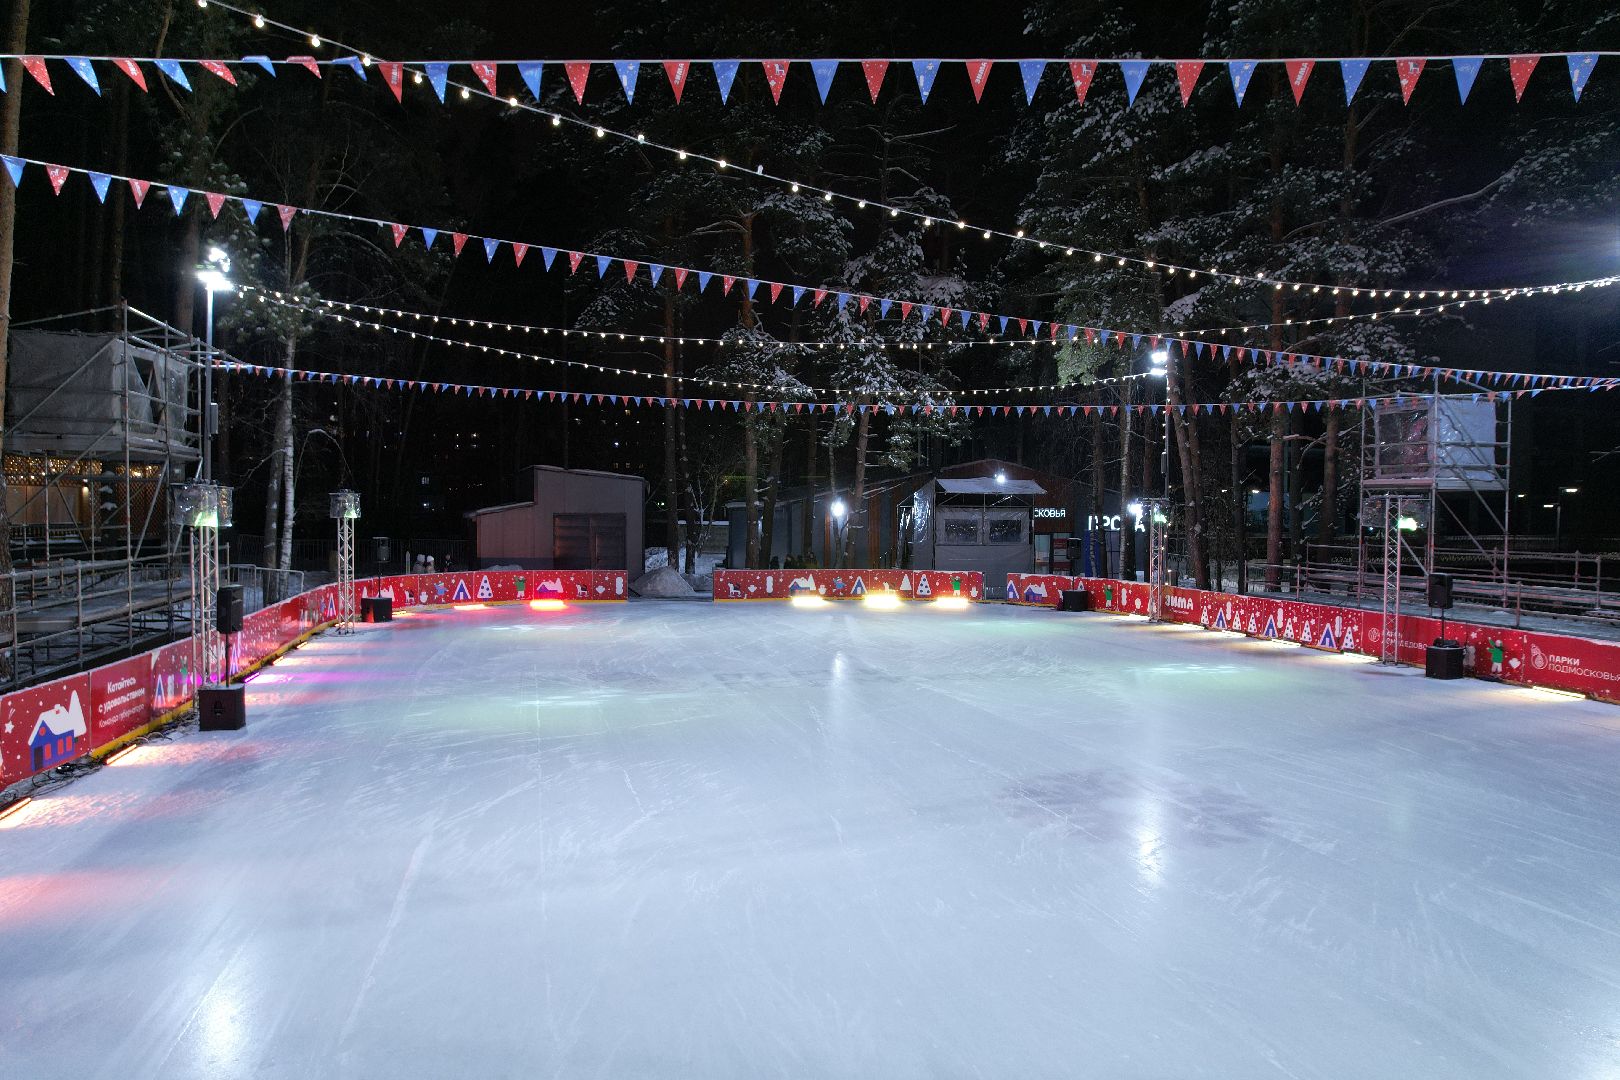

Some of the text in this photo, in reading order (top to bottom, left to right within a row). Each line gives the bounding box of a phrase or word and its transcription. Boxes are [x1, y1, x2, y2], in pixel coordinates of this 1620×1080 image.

[1165, 594, 1194, 610] ЗИМА
[1549, 654, 1580, 666] ПАРКИ
[1548, 663, 1620, 681] ПОДМОСКОВЬЯ
